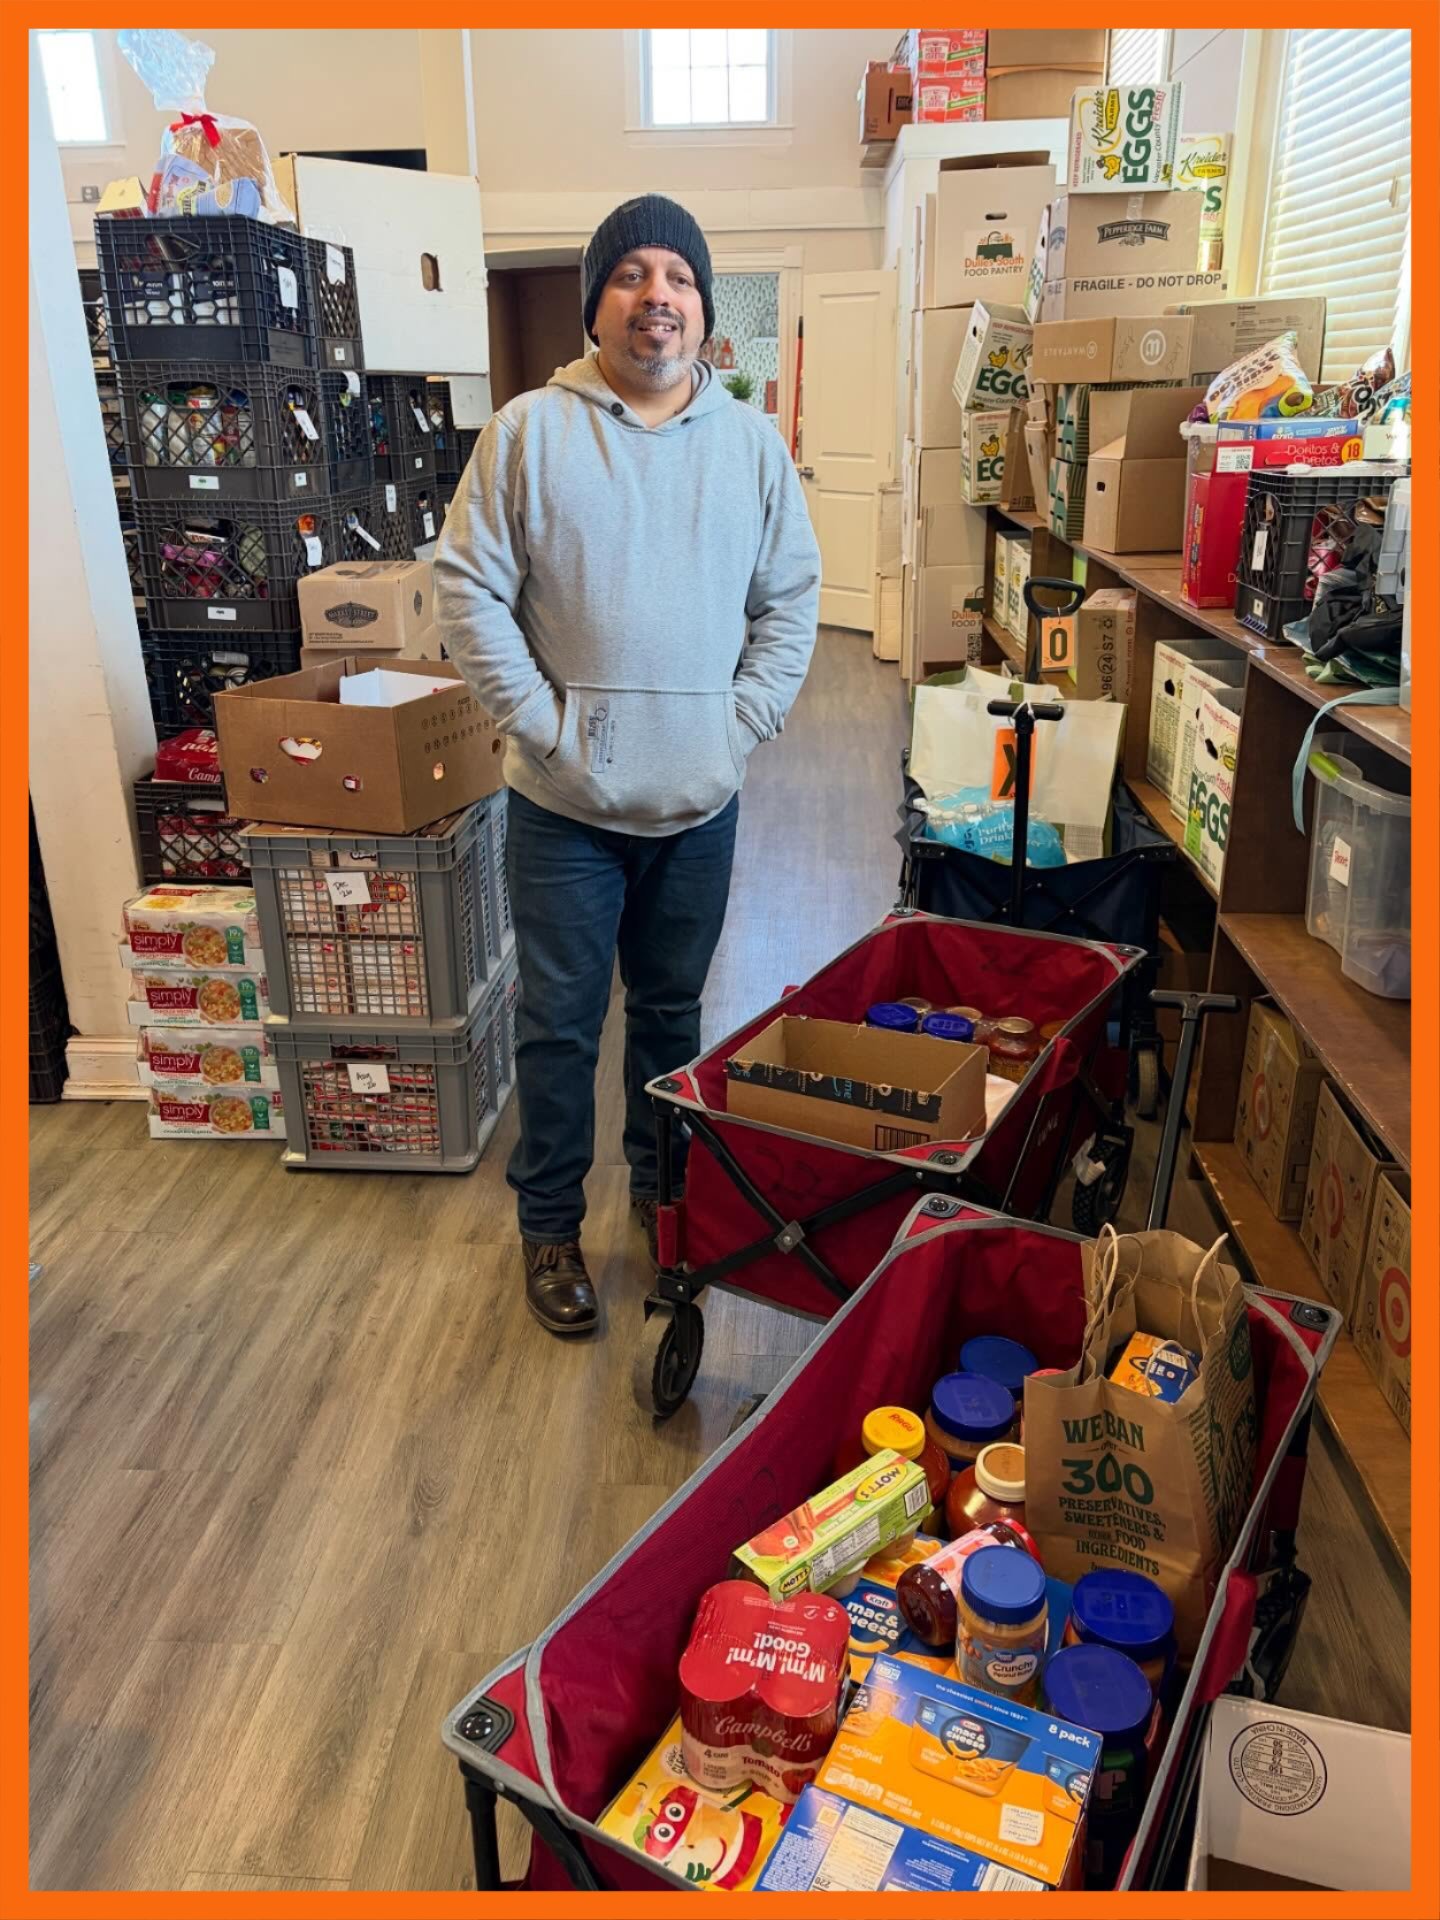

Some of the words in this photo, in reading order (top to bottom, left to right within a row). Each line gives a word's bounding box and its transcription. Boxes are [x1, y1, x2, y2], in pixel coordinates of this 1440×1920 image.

[1122, 88, 1156, 183] EGGS
[964, 269, 989, 277] FOOD
[990, 266, 1024, 275] PANTRY
[1073, 278, 1126, 292] FRAGILE
[1136, 277, 1155, 289] DO
[1157, 275, 1184, 288] NOT
[1186, 273, 1222, 287] DROP
[976, 367, 1030, 399] EGG
[1287, 444, 1328, 456] Doritos
[1330, 443, 1341, 454] &
[1346, 442, 1361, 459] 18
[1188, 771, 1231, 852] EGGS
[134, 932, 178, 951] simply
[150, 987, 192, 1005] simply
[152, 1054, 195, 1069] simply
[162, 1104, 205, 1119] simply
[1062, 1414, 1103, 1444] WE
[1103, 1409, 1145, 1452] BAN
[1061, 1452, 1154, 1505] 300
[1058, 1495, 1167, 1529] PRESERVATIVES,
[1064, 1511, 1151, 1537] SWEETENERS
[1153, 1528, 1165, 1542] &
[1115, 1529, 1146, 1551] FOOD
[1076, 1539, 1160, 1576] INGREDIENTS
[868, 1595, 890, 1608] Kraft
[846, 1602, 885, 1623] mac
[886, 1615, 898, 1629] &
[753, 1632, 811, 1658] Good!
[1048, 1724, 1057, 1735] 8
[1059, 1729, 1091, 1748] pack
[1250, 1724, 1276, 1735] CHINA
[1287, 1727, 1308, 1746] MADE
[703, 1749, 713, 1759] 4
[840, 1743, 884, 1765] original
[741, 1756, 781, 1778] Tomato
